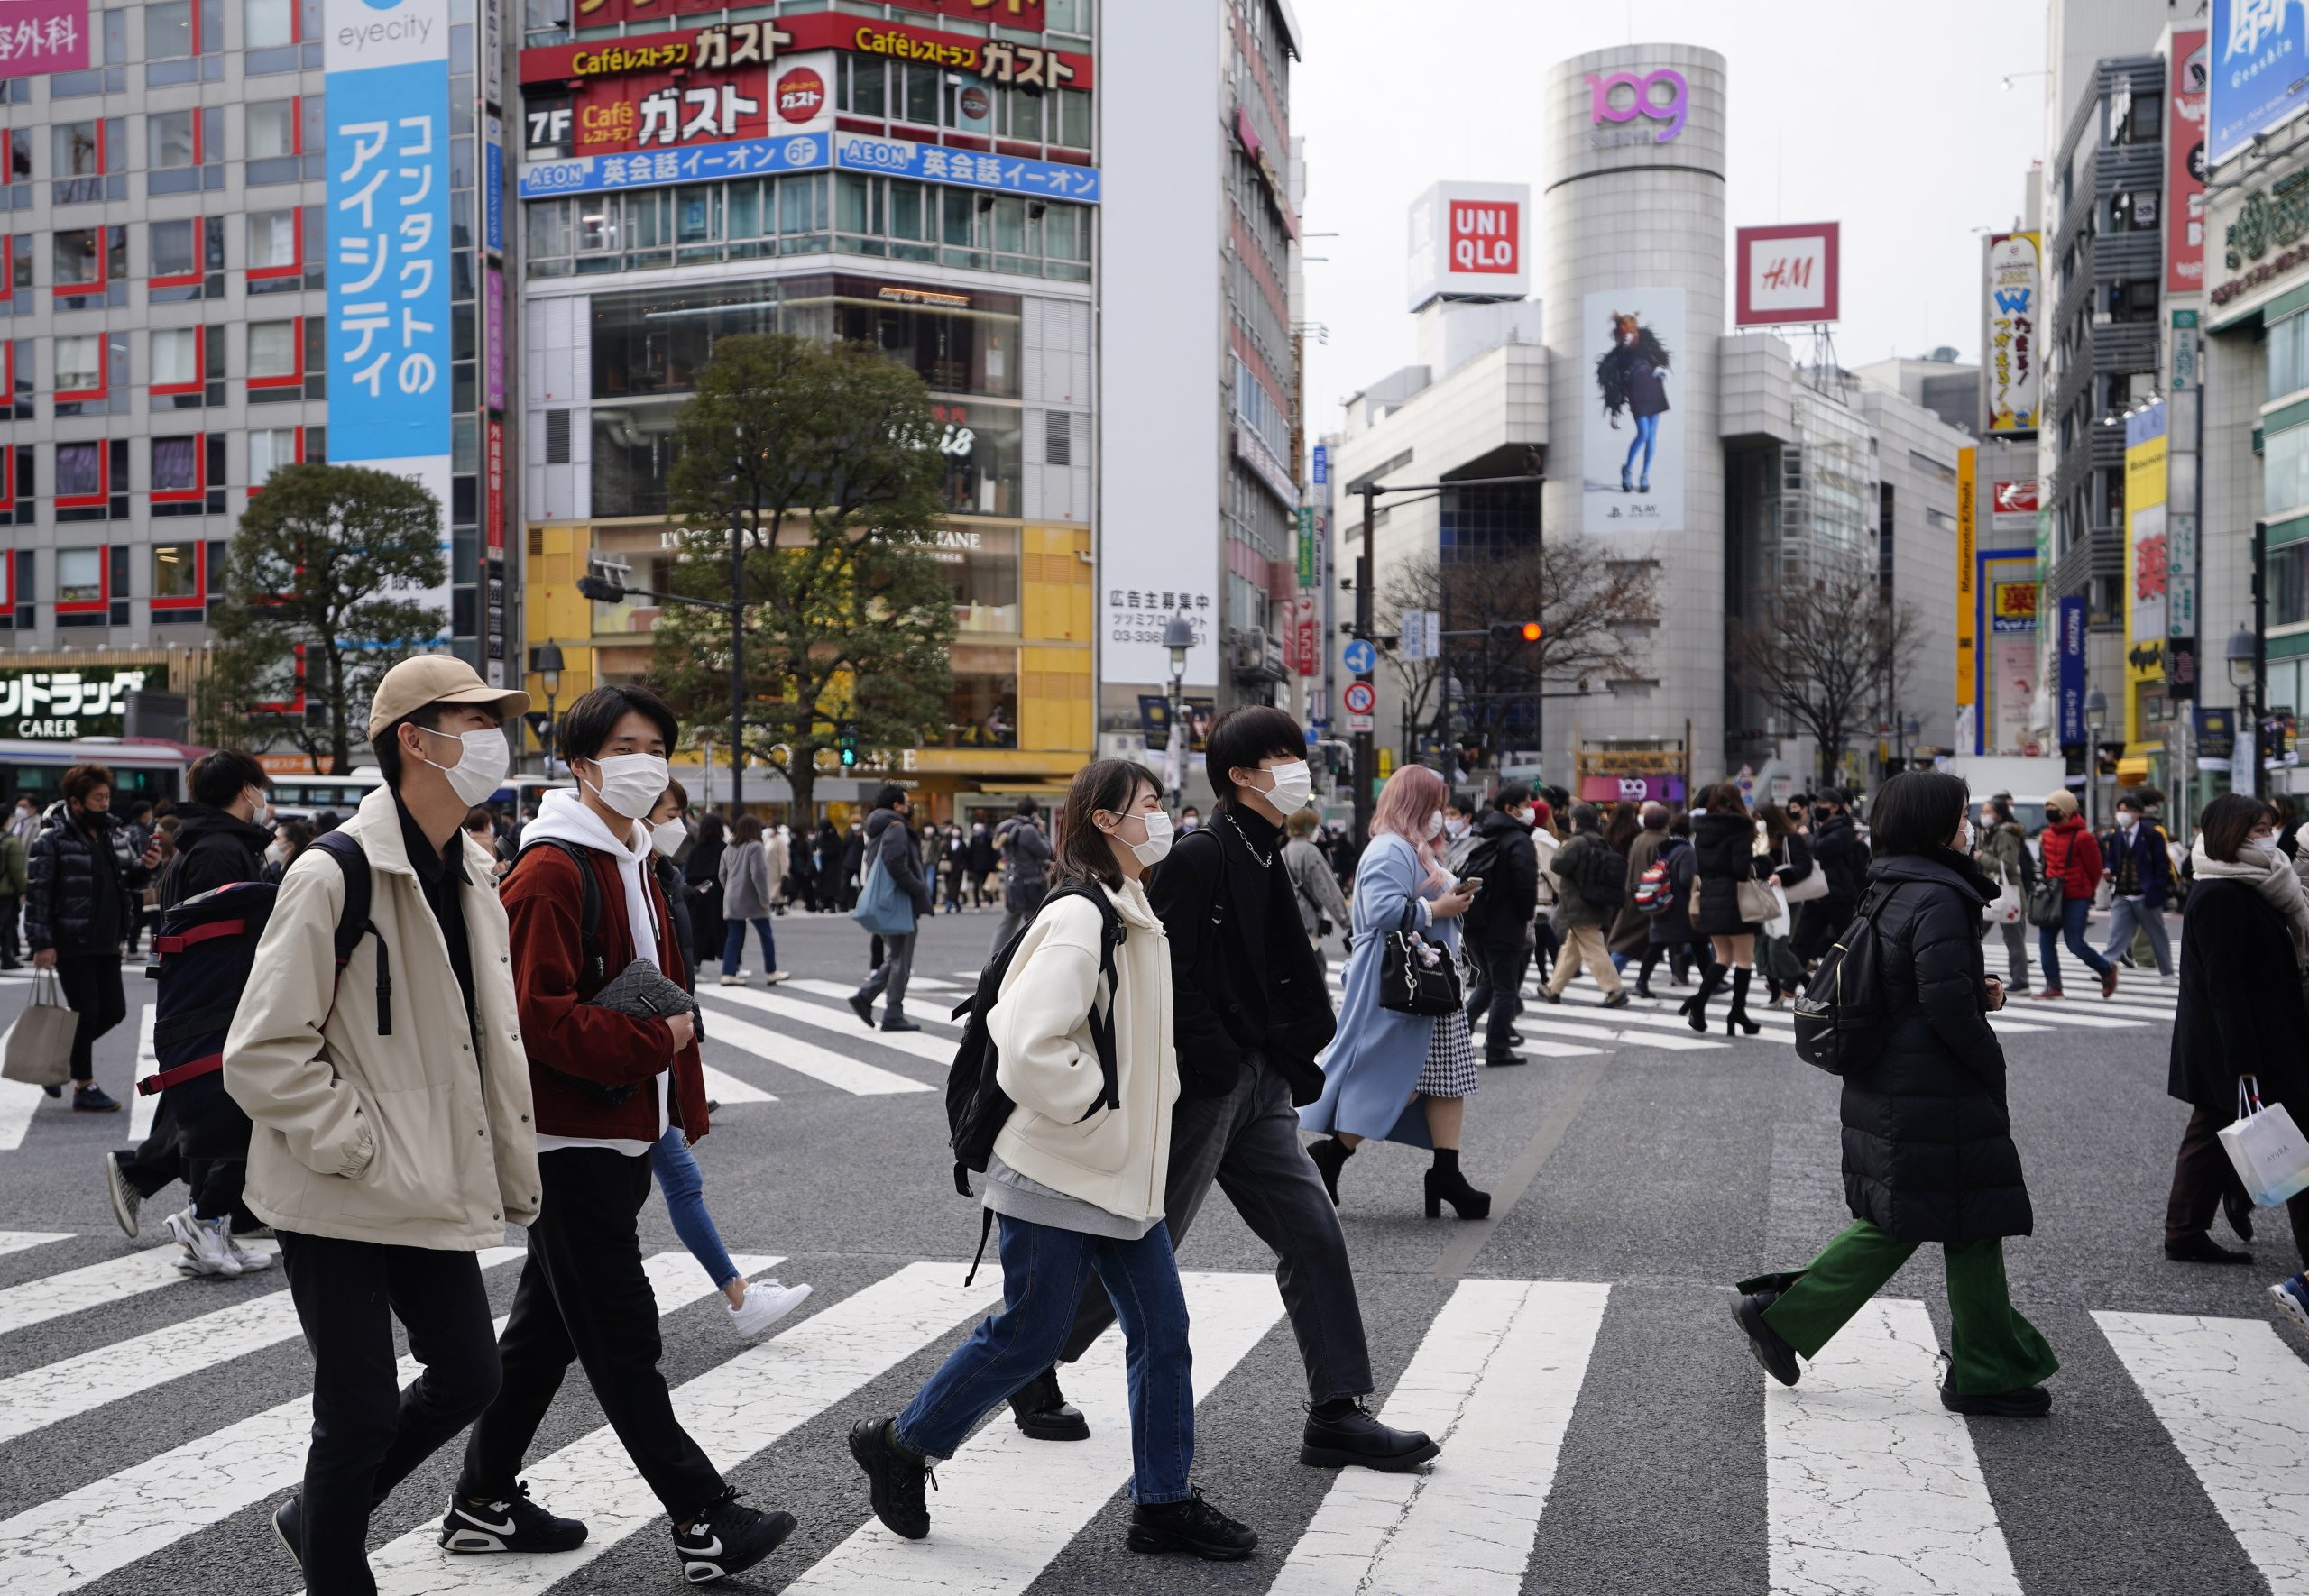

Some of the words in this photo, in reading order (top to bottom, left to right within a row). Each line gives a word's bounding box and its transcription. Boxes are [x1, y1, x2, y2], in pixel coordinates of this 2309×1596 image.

[338, 14, 433, 51] eyecity
[695, 22, 792, 69] ガスト
[981, 42, 1074, 88] ガスト
[2231, 38, 2293, 87] Genshin
[582, 102, 634, 129] Café
[638, 85, 759, 147] ガスト
[780, 91, 822, 109] ガスト
[1584, 69, 1688, 143] 109
[528, 108, 572, 143] 7F
[526, 163, 584, 191] AEON
[603, 144, 776, 186] 英会話イーオン
[787, 142, 815, 163] 6F
[845, 138, 908, 168] AEON
[922, 149, 1095, 194] 英会話イーオン
[1456, 207, 1507, 236] UNI
[338, 120, 391, 398] アイシティ
[399, 115, 436, 394] コンタクトの
[1456, 238, 1513, 269] QLO
[1762, 256, 1814, 290] H&M
[1110, 590, 1210, 611] 広告主募集中
[18, 719, 78, 738] CARER
